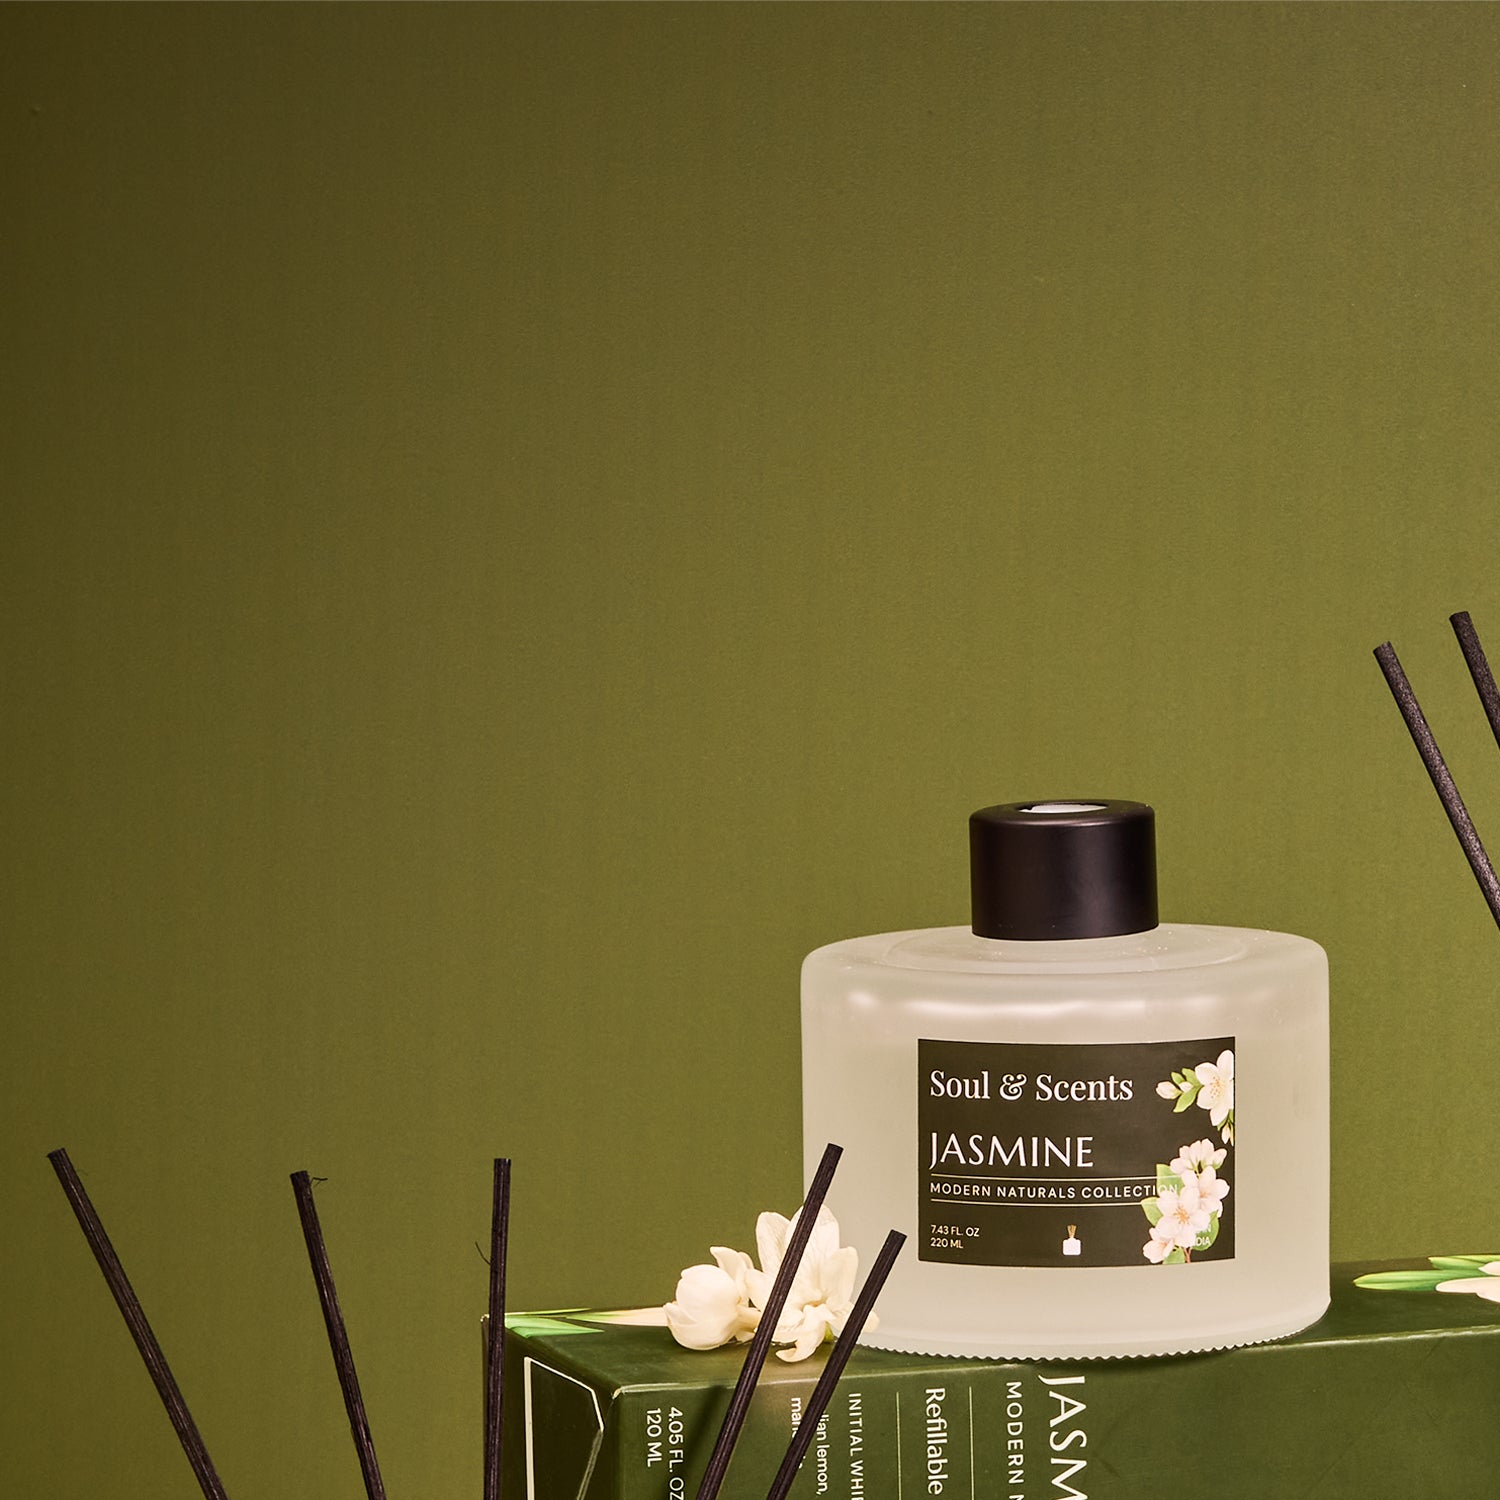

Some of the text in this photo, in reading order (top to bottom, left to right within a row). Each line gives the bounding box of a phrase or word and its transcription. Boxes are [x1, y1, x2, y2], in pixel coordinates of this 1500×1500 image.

[930, 1070, 1133, 1101] Soul & Scents
[929, 1132, 1094, 1170] JASMINE
[930, 1182, 1076, 1199] MODERN NATURALS
[930, 1224, 980, 1237] 7.43 FL. OZ
[930, 1237, 964, 1249] 220 ML
[646, 1408, 662, 1468] 120 ML
[849, 1393, 863, 1457] INITIAL
[925, 1388, 948, 1495] Refillable
[1006, 1381, 1024, 1484] MODERN
[668, 1406, 684, 1500] 4.05 FL. OZ
[815, 1445, 830, 1496] lemon,
